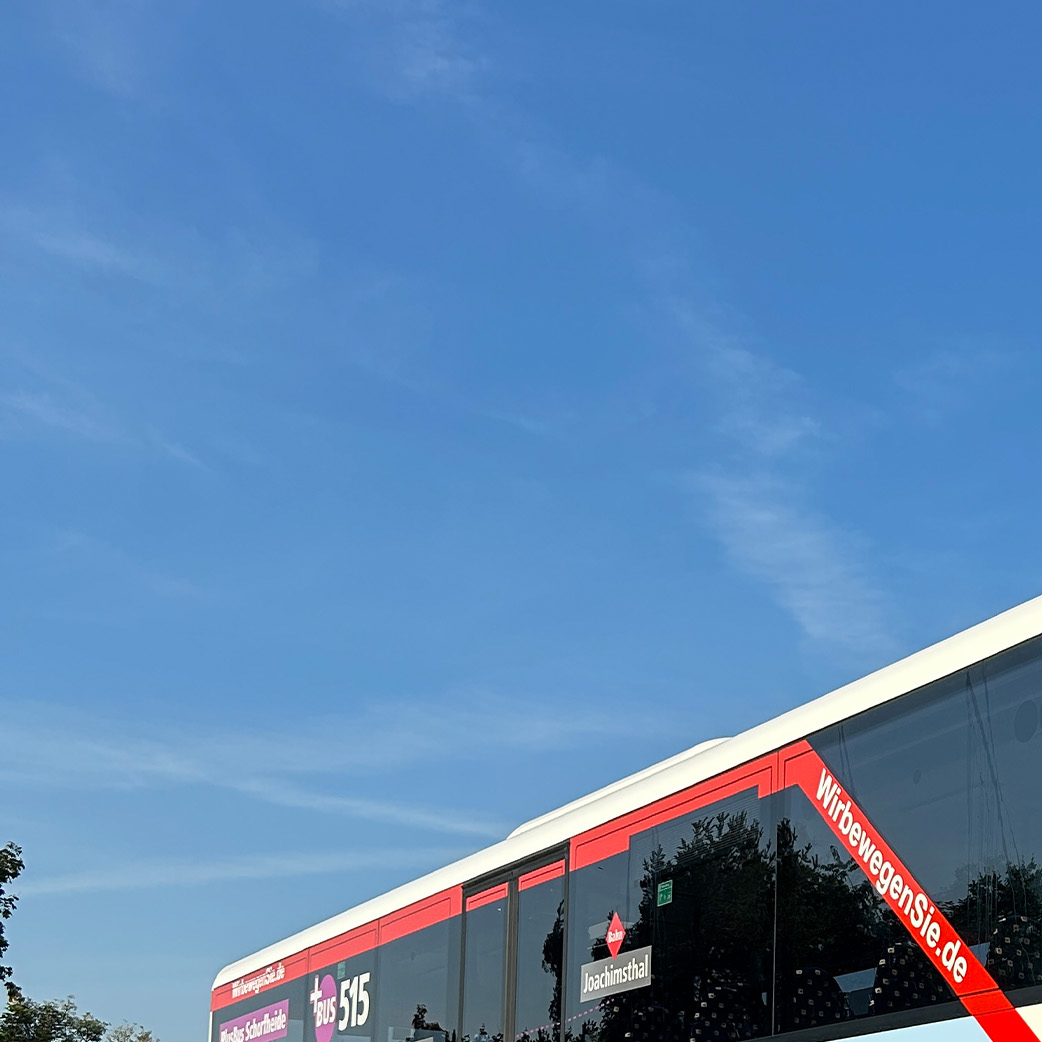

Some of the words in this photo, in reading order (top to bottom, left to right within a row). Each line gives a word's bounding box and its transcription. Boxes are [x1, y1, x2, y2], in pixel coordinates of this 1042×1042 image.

[816, 768, 967, 983] WirbewegenSie.de
[583, 954, 649, 993] Joachimsthal
[245, 1008, 287, 1042] Schorfheide
[338, 972, 371, 1032] 515
